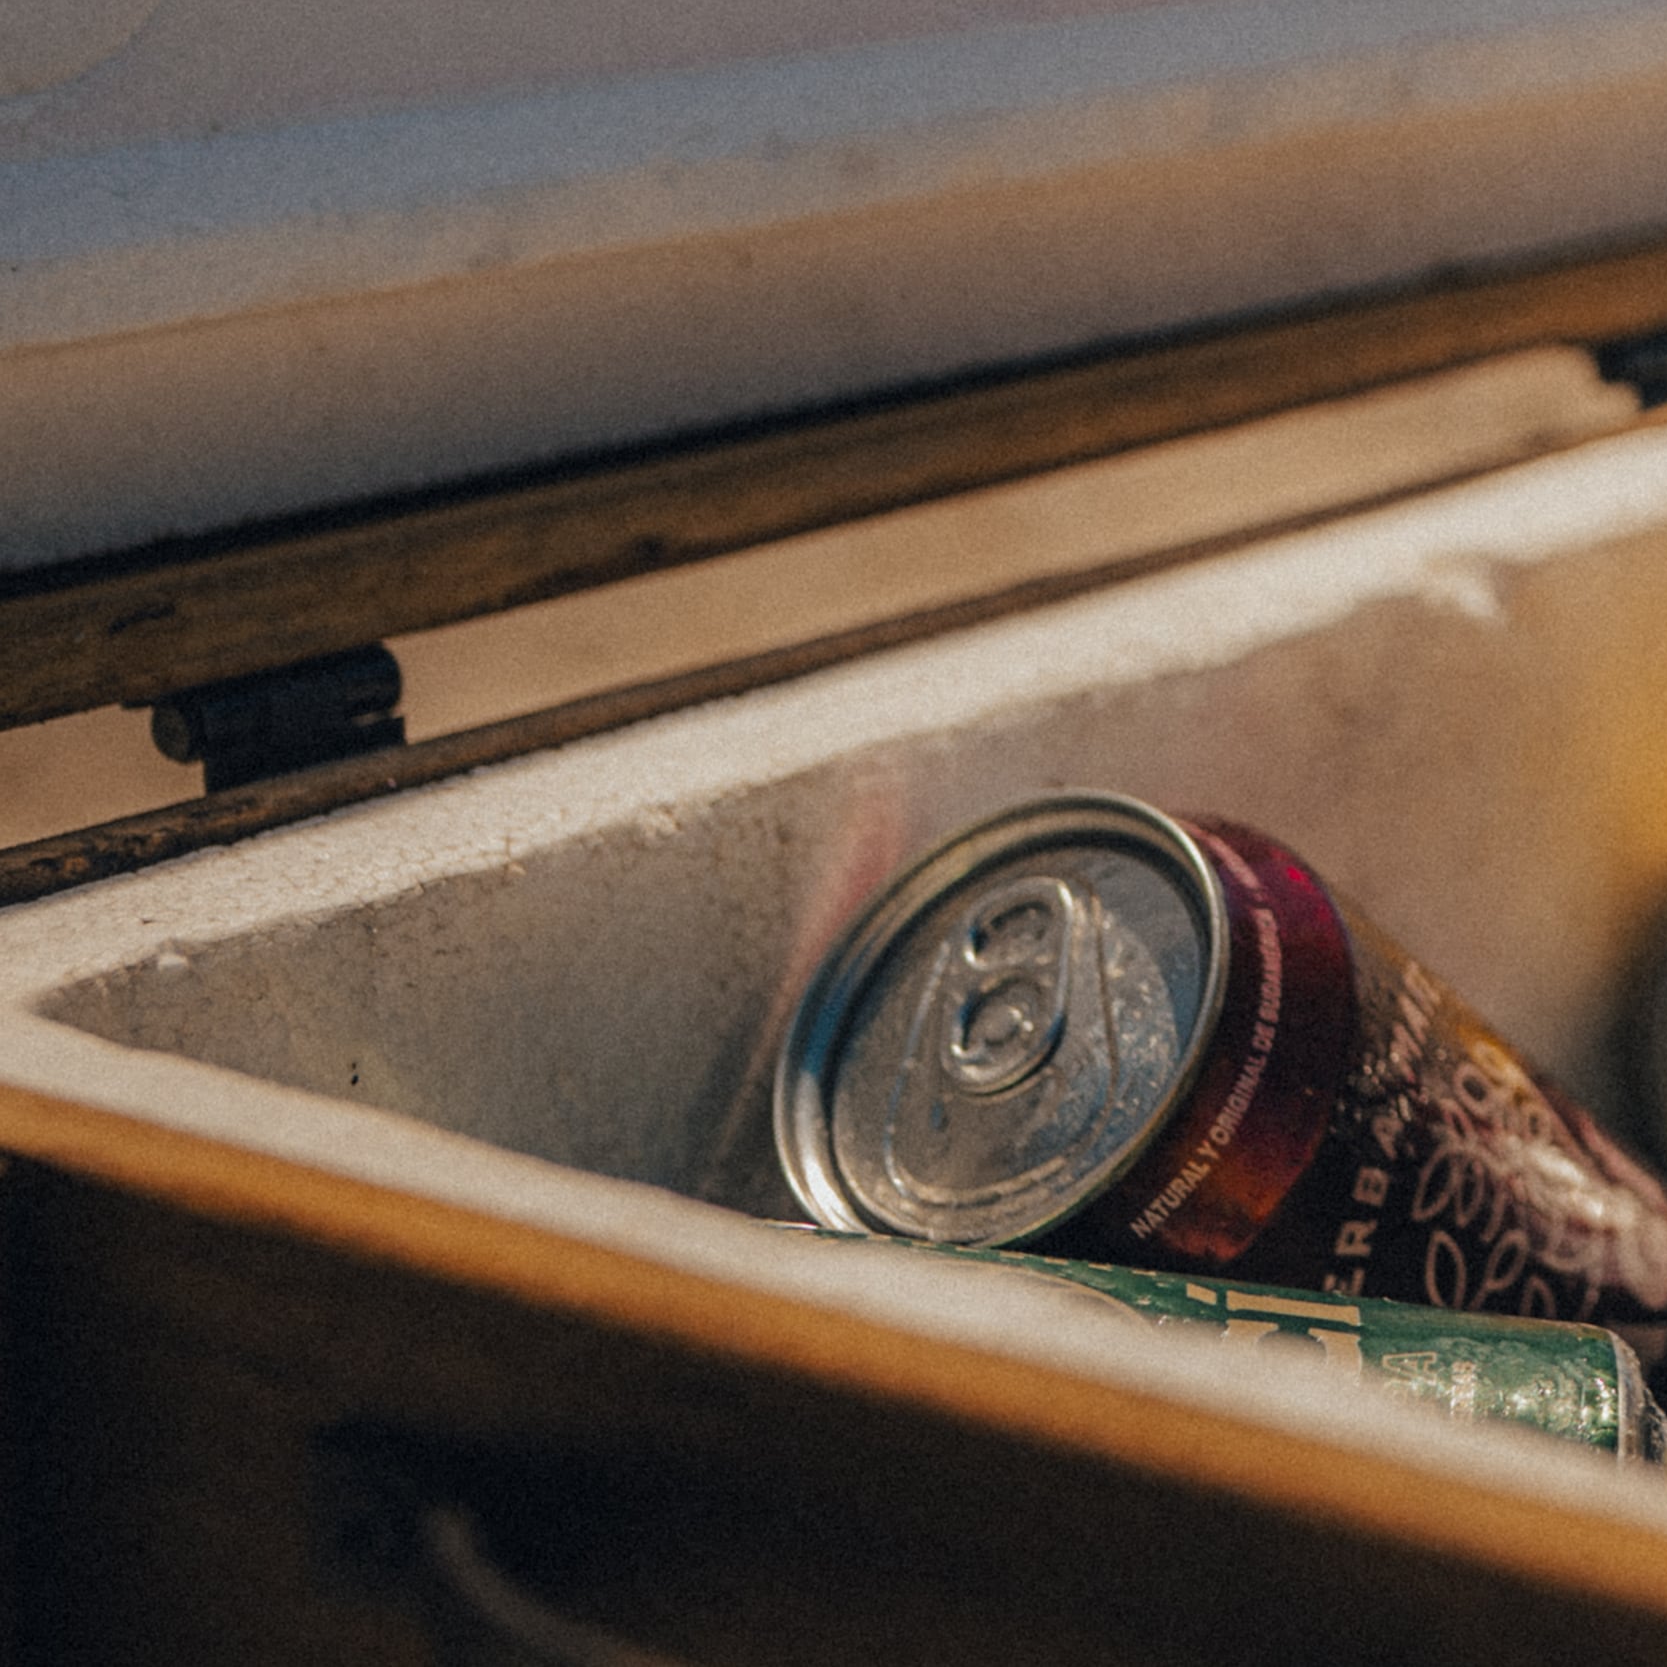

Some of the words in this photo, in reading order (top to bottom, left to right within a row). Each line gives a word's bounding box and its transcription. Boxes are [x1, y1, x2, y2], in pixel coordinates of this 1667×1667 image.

[1129, 1149, 1211, 1239] NATURAL
[1198, 1138, 1221, 1162] Y
[1213, 1056, 1268, 1147] ORIGINAL
[1251, 1021, 1277, 1055] DE
[1323, 1113, 1406, 1297] ERBA
